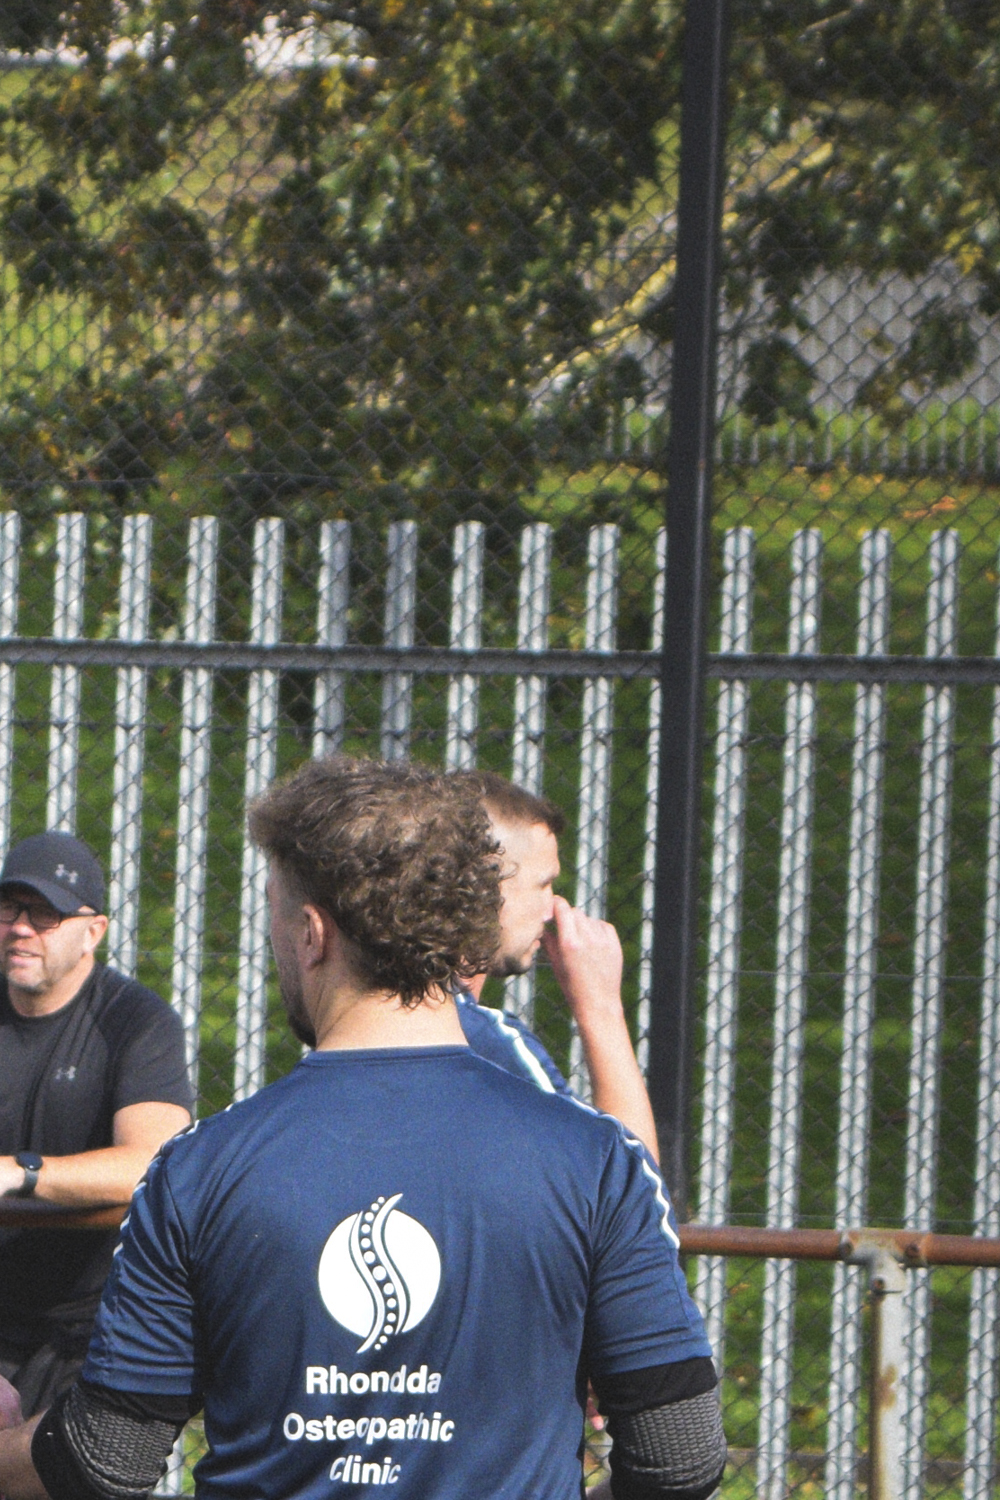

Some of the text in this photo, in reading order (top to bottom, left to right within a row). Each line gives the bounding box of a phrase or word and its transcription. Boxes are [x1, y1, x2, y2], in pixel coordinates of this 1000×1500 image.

[306, 1365, 442, 1394] Rhondda
[283, 1412, 455, 1445] Osteopathic
[329, 1455, 401, 1485] Clinic
